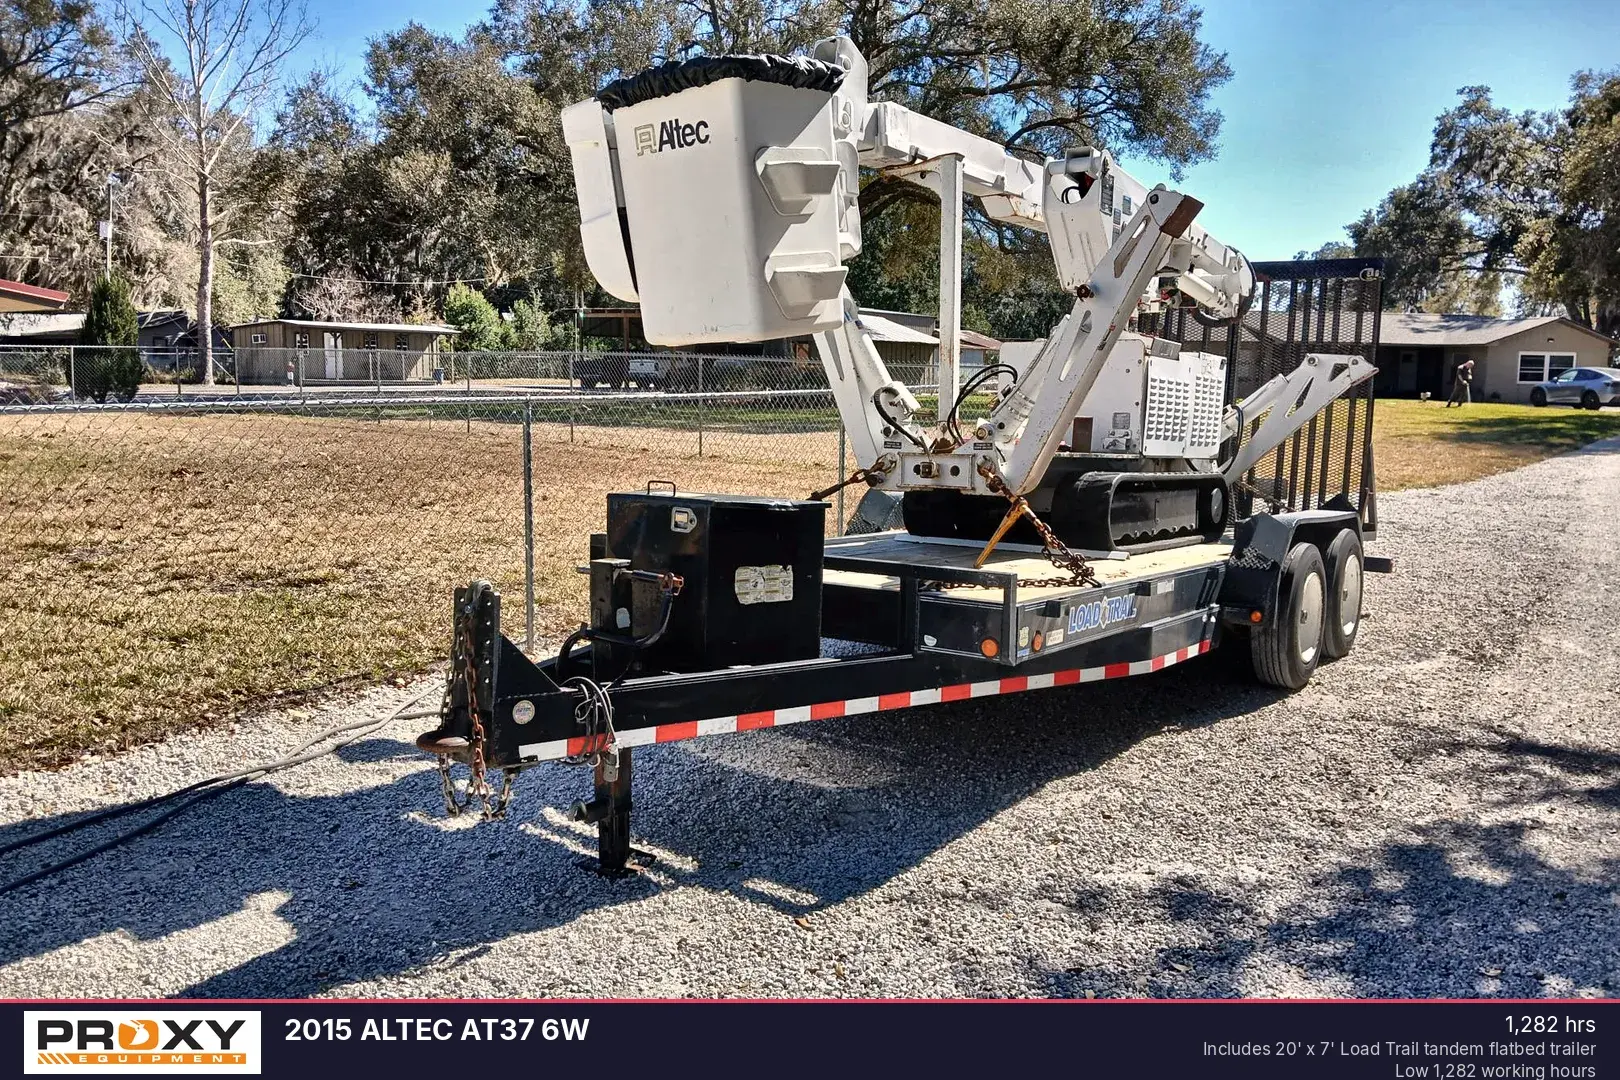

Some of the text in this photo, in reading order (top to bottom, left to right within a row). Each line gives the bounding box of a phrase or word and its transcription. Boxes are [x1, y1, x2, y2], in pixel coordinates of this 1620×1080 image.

[658, 118, 710, 152] Altec
[1068, 593, 1137, 634] LOAD TRAIL
